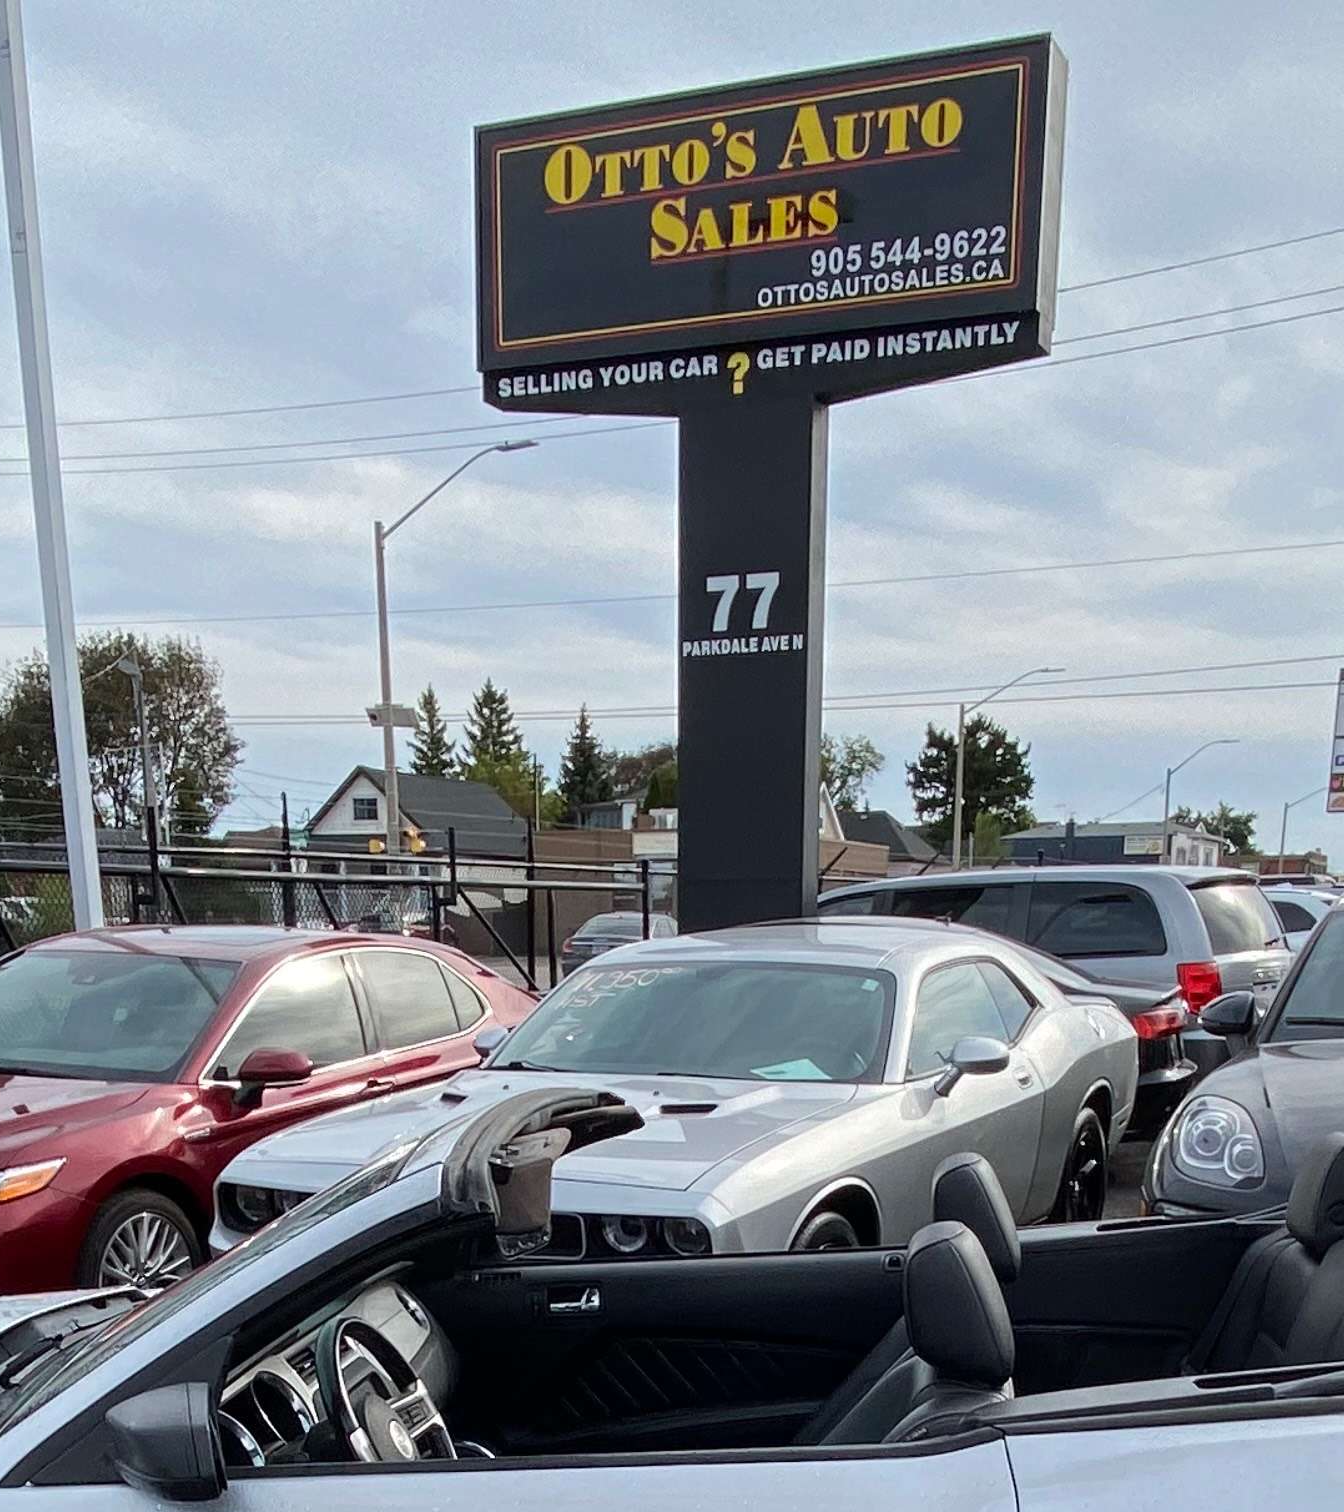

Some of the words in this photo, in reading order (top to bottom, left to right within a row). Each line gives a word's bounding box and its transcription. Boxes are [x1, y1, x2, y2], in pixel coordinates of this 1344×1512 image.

[544, 121, 757, 205] OTTO'S
[778, 98, 963, 170] AUTO
[650, 188, 839, 260] SALES
[810, 243, 863, 278] 905
[870, 225, 1008, 269] 544-9622
[757, 259, 1005, 308] OTTOSAUTOSALES.CA
[498, 368, 594, 398] SELLING
[598, 362, 663, 389] YOUR
[669, 354, 718, 379] CAR
[756, 344, 803, 370] GET
[811, 337, 870, 365] PAID
[877, 321, 1020, 358] INSTANTLY
[706, 572, 780, 632] 77
[682, 637, 758, 657] PARKDALE
[761, 635, 789, 652] AVE
[792, 634, 803, 650] N
